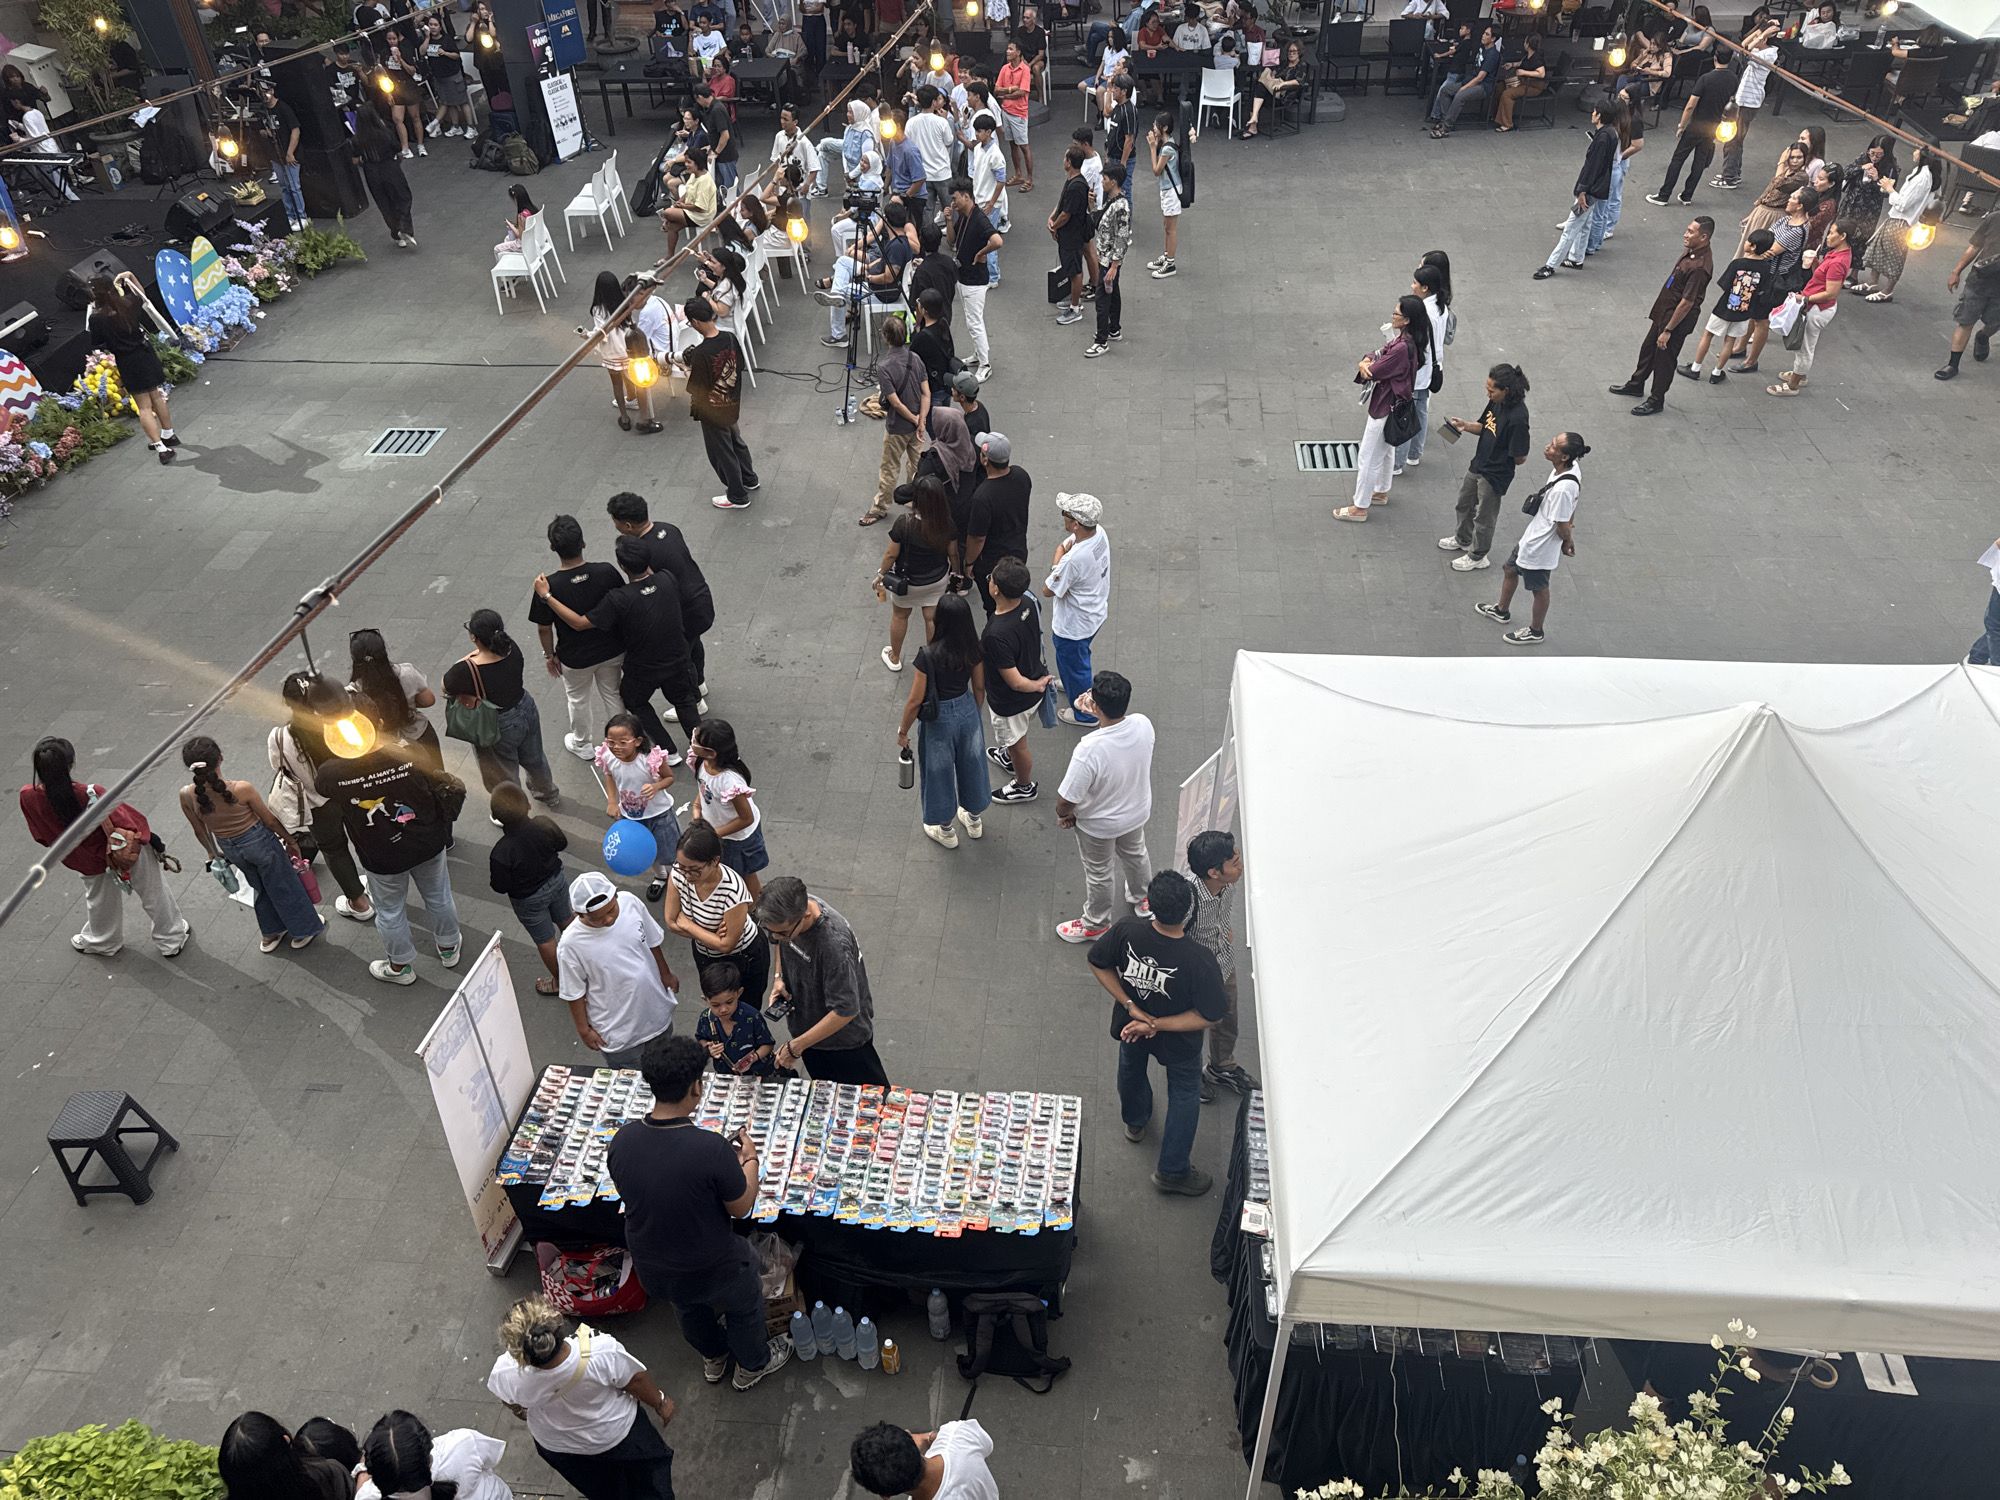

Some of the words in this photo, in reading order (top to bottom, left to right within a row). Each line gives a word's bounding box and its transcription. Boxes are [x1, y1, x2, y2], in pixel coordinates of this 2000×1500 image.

[532, 35, 548, 48] PIANO
[338, 776, 365, 786] FRIENDS
[367, 768, 396, 780] ALWAYS
